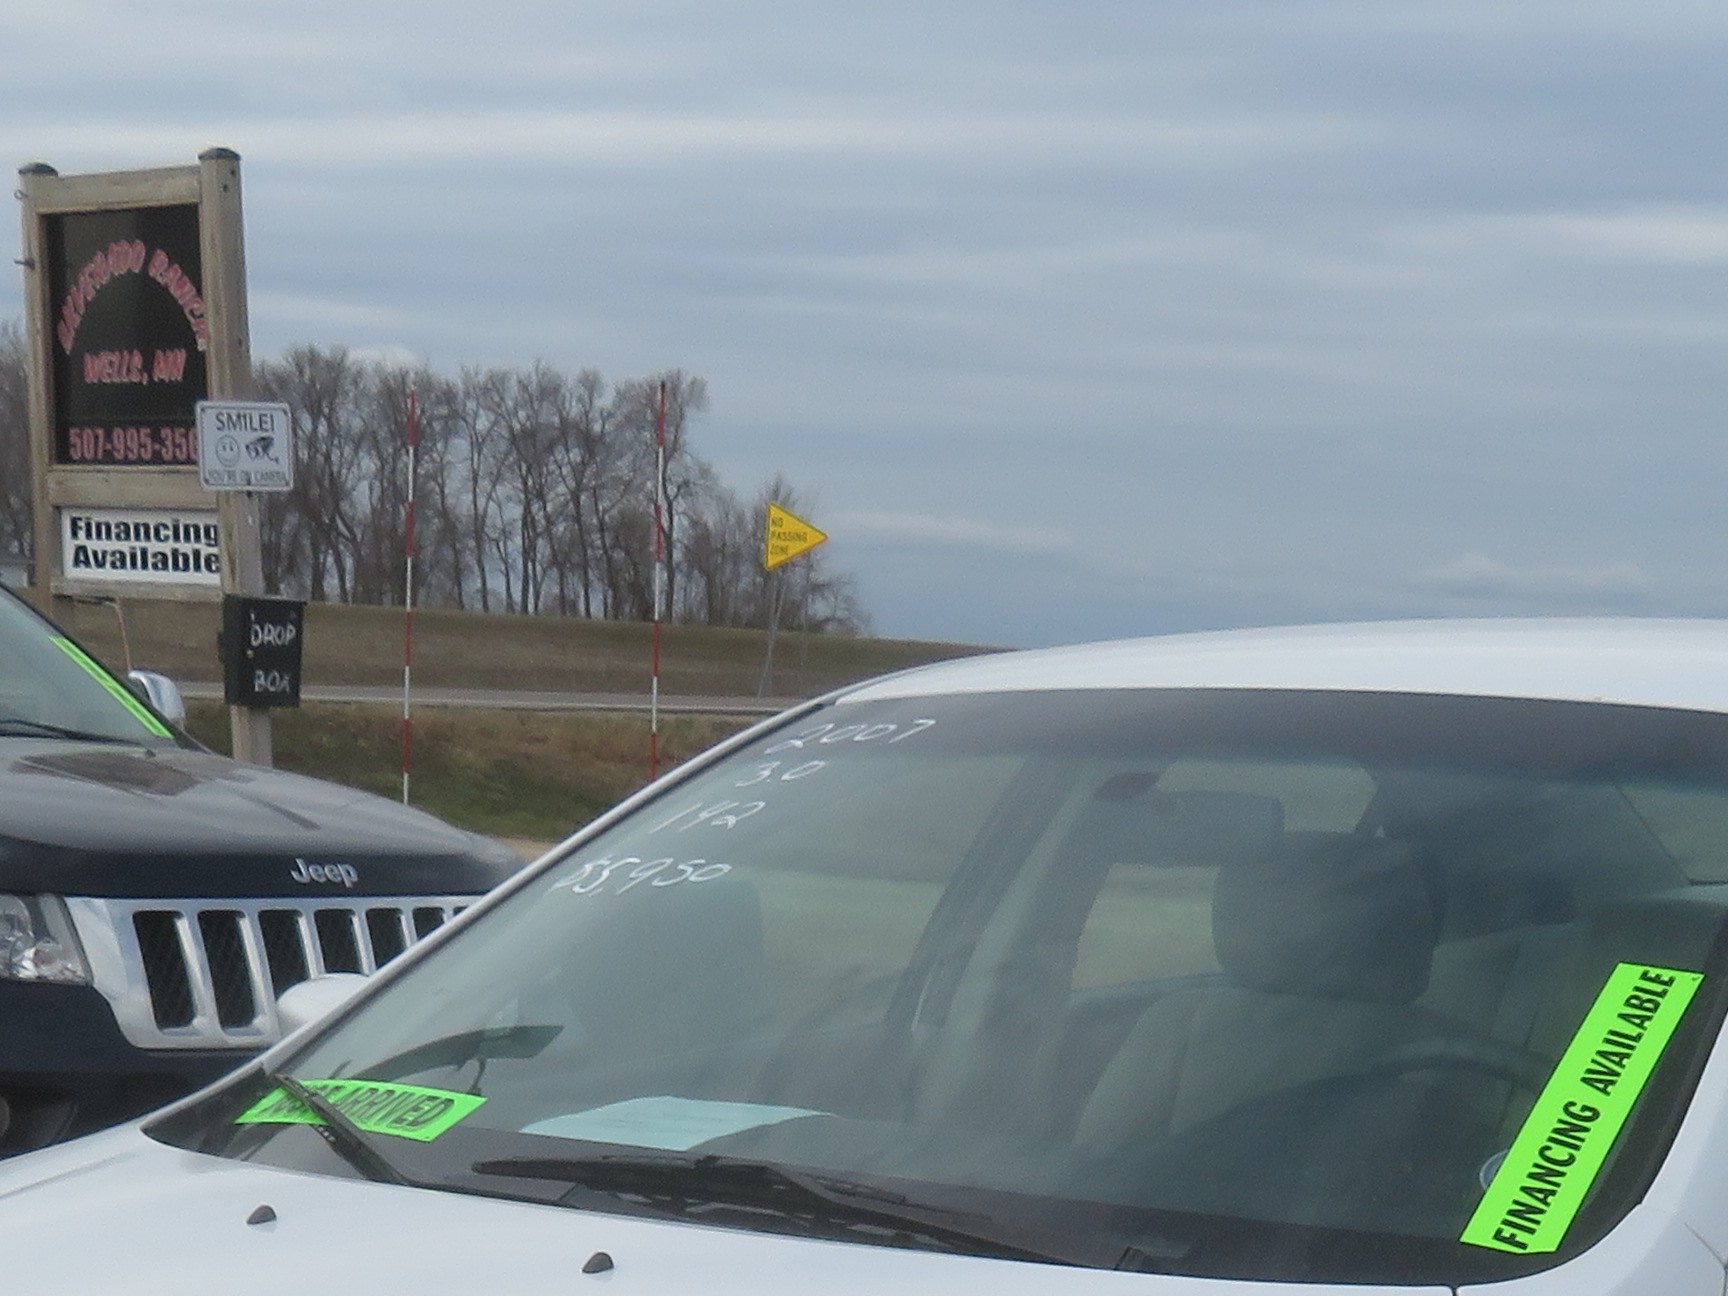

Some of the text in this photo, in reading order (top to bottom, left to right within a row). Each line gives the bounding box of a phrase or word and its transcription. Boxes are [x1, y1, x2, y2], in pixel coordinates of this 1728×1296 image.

[83, 349, 187, 385] WELLS, MN
[70, 516, 219, 547] Financing
[771, 517, 784, 528] NO
[771, 531, 808, 543] PASSING
[73, 545, 220, 573] Available
[770, 545, 789, 556] ZONE
[250, 622, 297, 647] DROP
[254, 670, 290, 694] BOX
[764, 719, 936, 755] 2007
[290, 858, 358, 888] Jeep
[333, 1088, 455, 1130] ARRIVED
[1492, 969, 1676, 1250] FINANCING AVAILABLE
